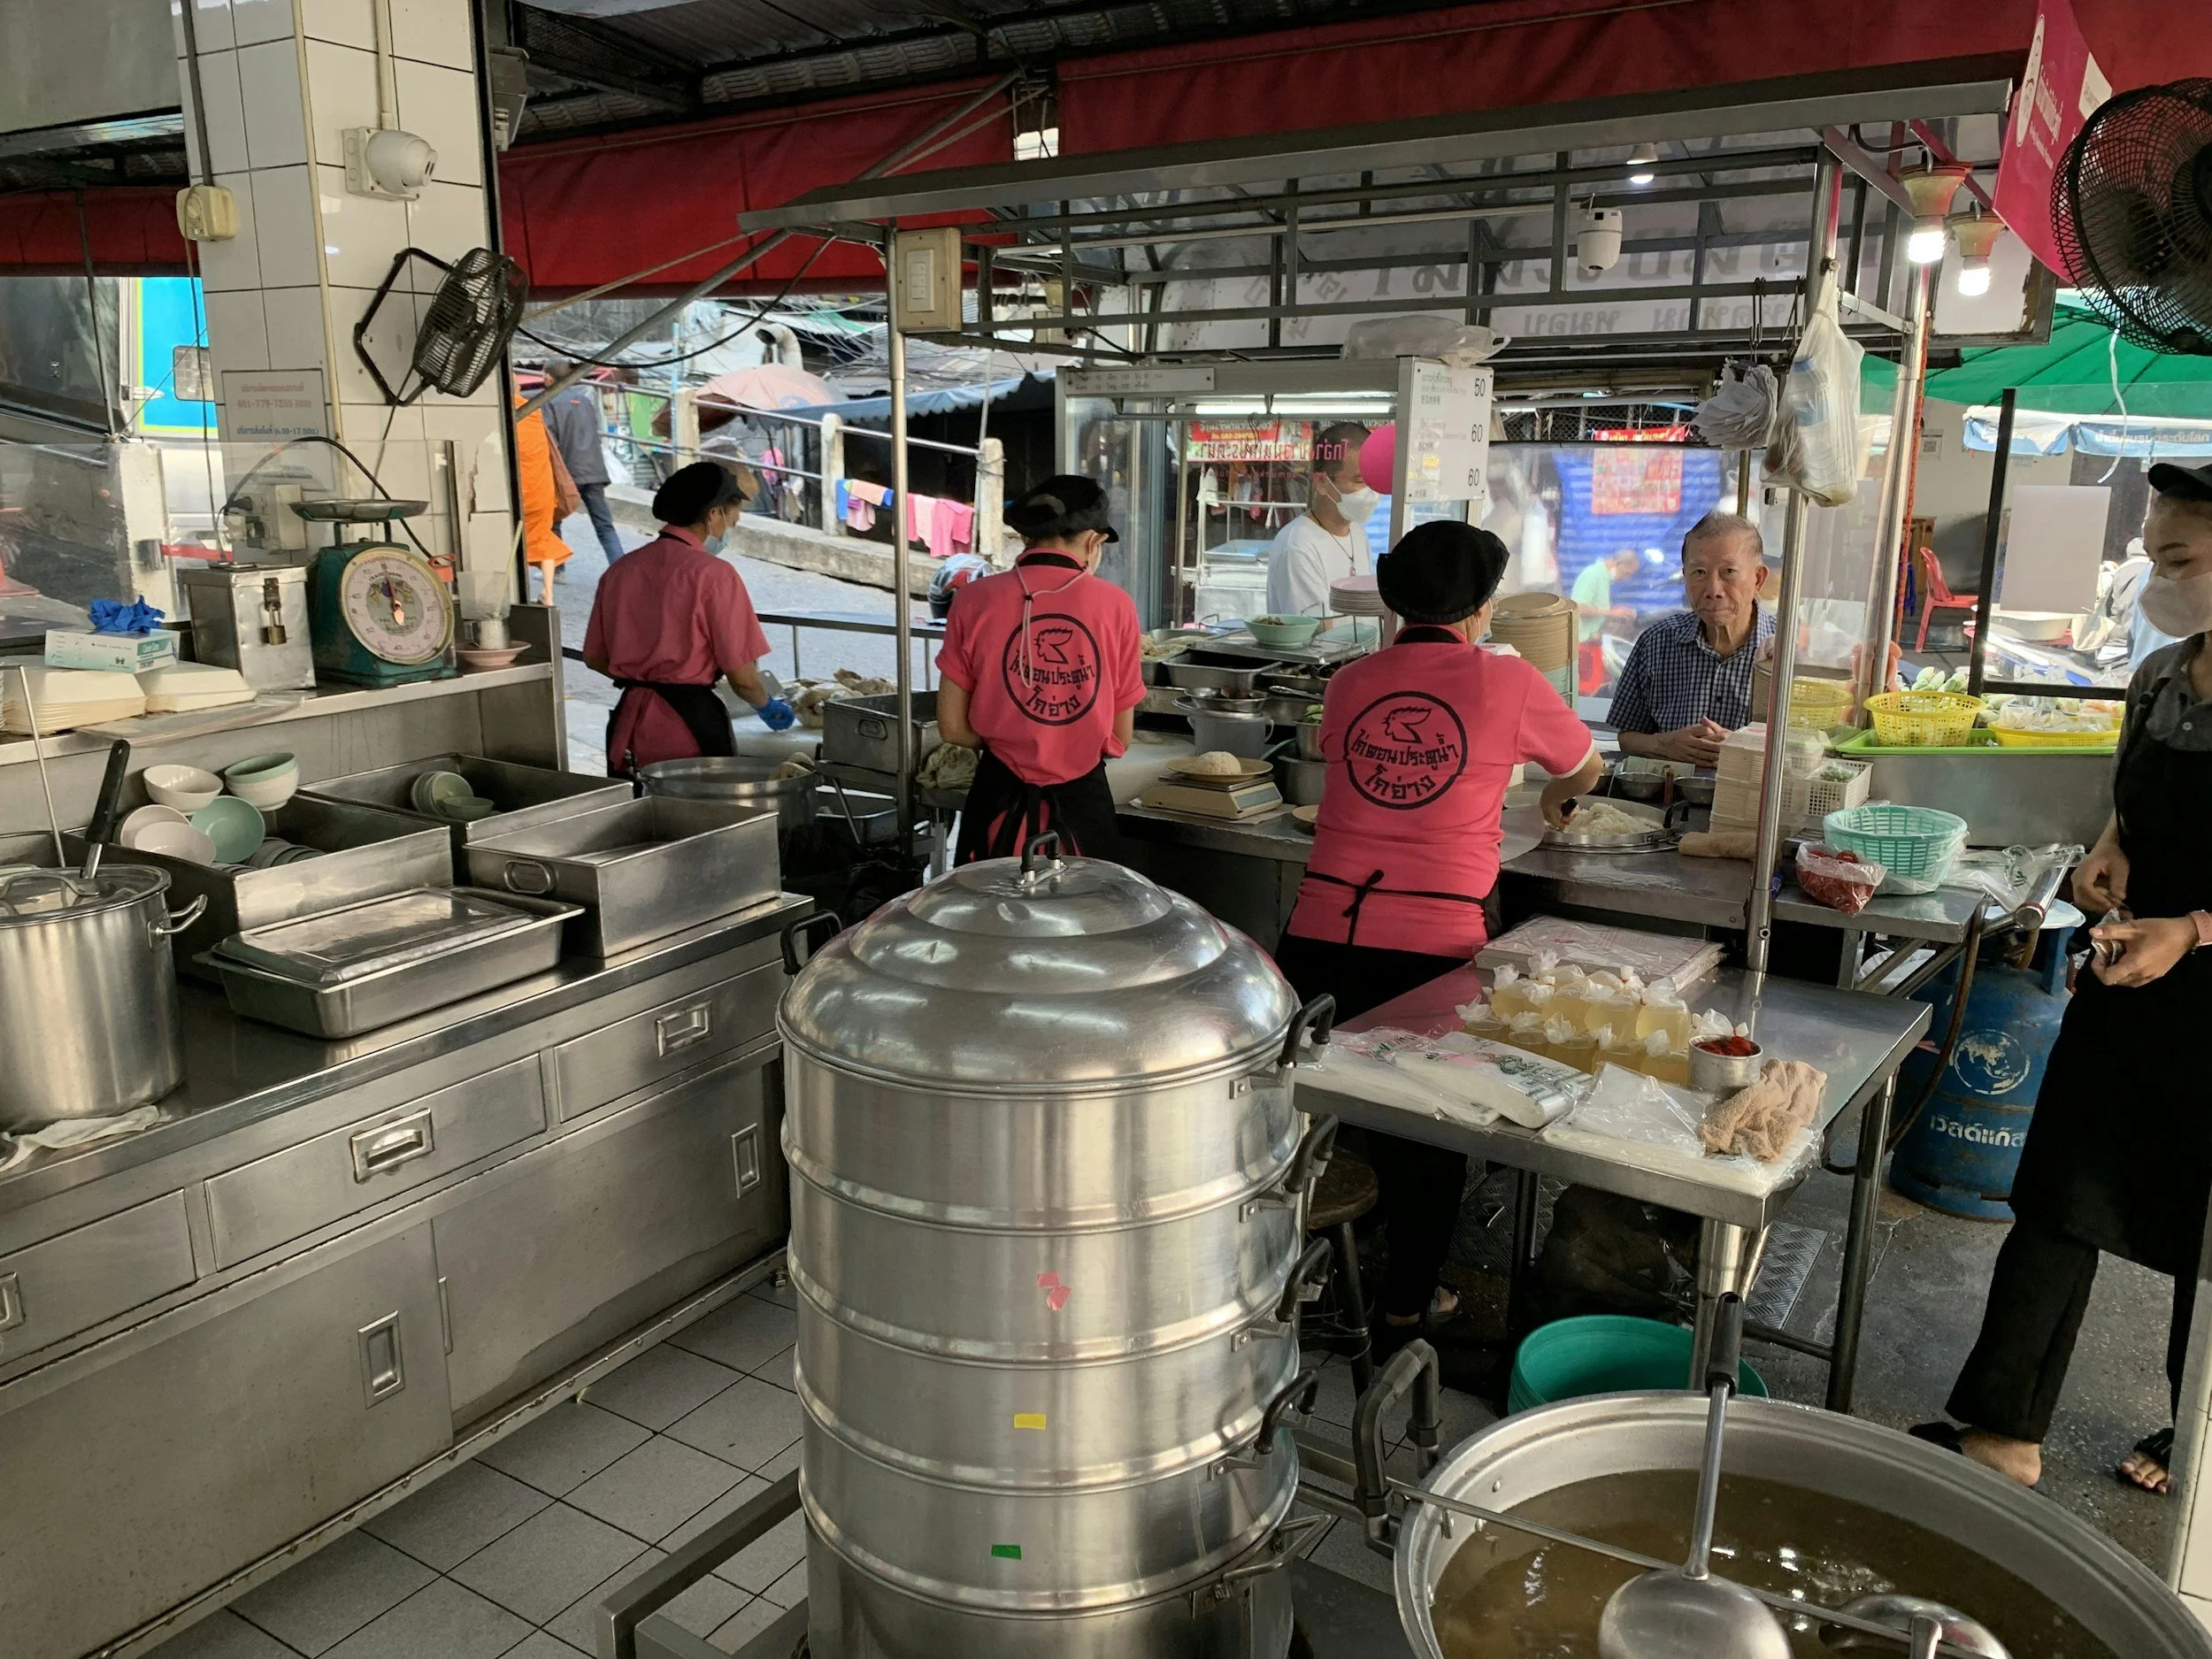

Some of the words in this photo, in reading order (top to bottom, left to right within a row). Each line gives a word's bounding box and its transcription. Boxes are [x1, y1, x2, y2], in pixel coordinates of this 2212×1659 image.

[1474, 378, 1486, 396] 50
[1471, 424, 1483, 442] 60
[1468, 468, 1479, 487] 60
[1025, 684, 1081, 717] โกอ่าง
[1350, 727, 1459, 771] ไก่ตอนประตูน้ำ
[1364, 763, 1436, 800] โกอ่าง
